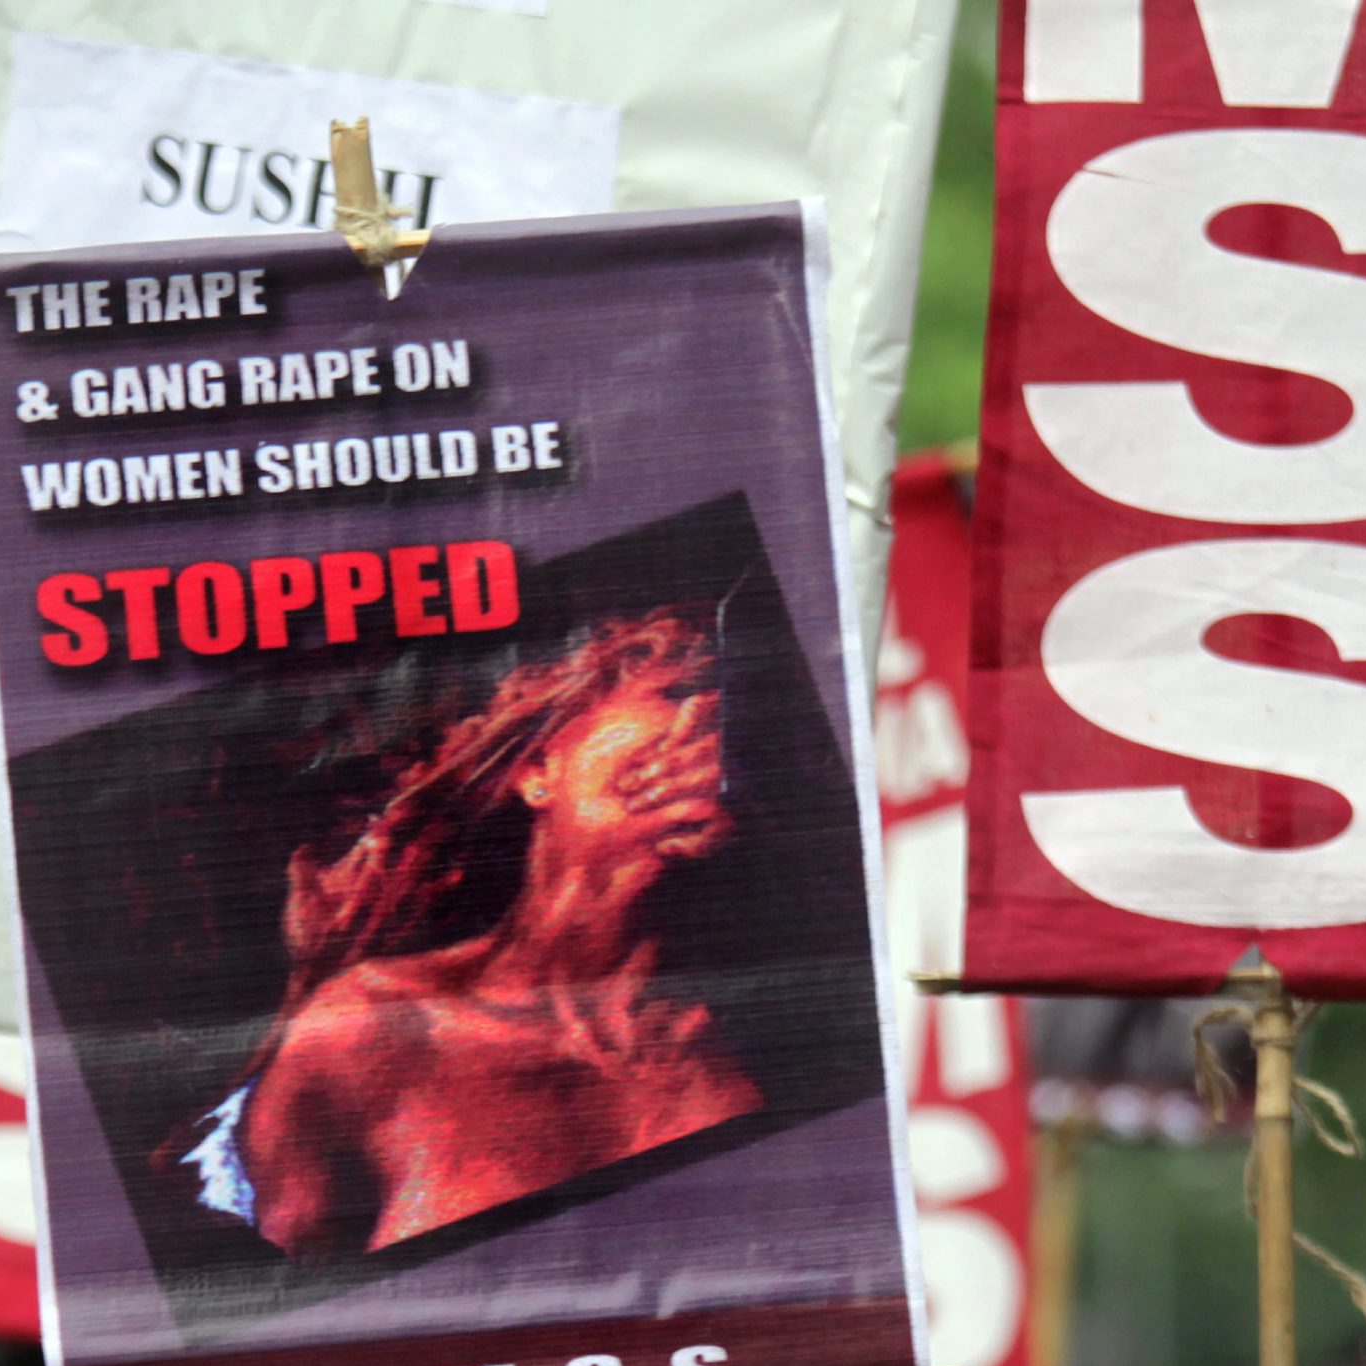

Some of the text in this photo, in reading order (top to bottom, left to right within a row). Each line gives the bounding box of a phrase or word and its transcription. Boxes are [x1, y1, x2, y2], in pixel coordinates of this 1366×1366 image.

[7, 270, 267, 332] THE RAPE
[17, 340, 471, 422] & GANG RAPE ON
[21, 422, 562, 511] WOMEN SHOULD BE
[36, 540, 521, 667] STOPPED
